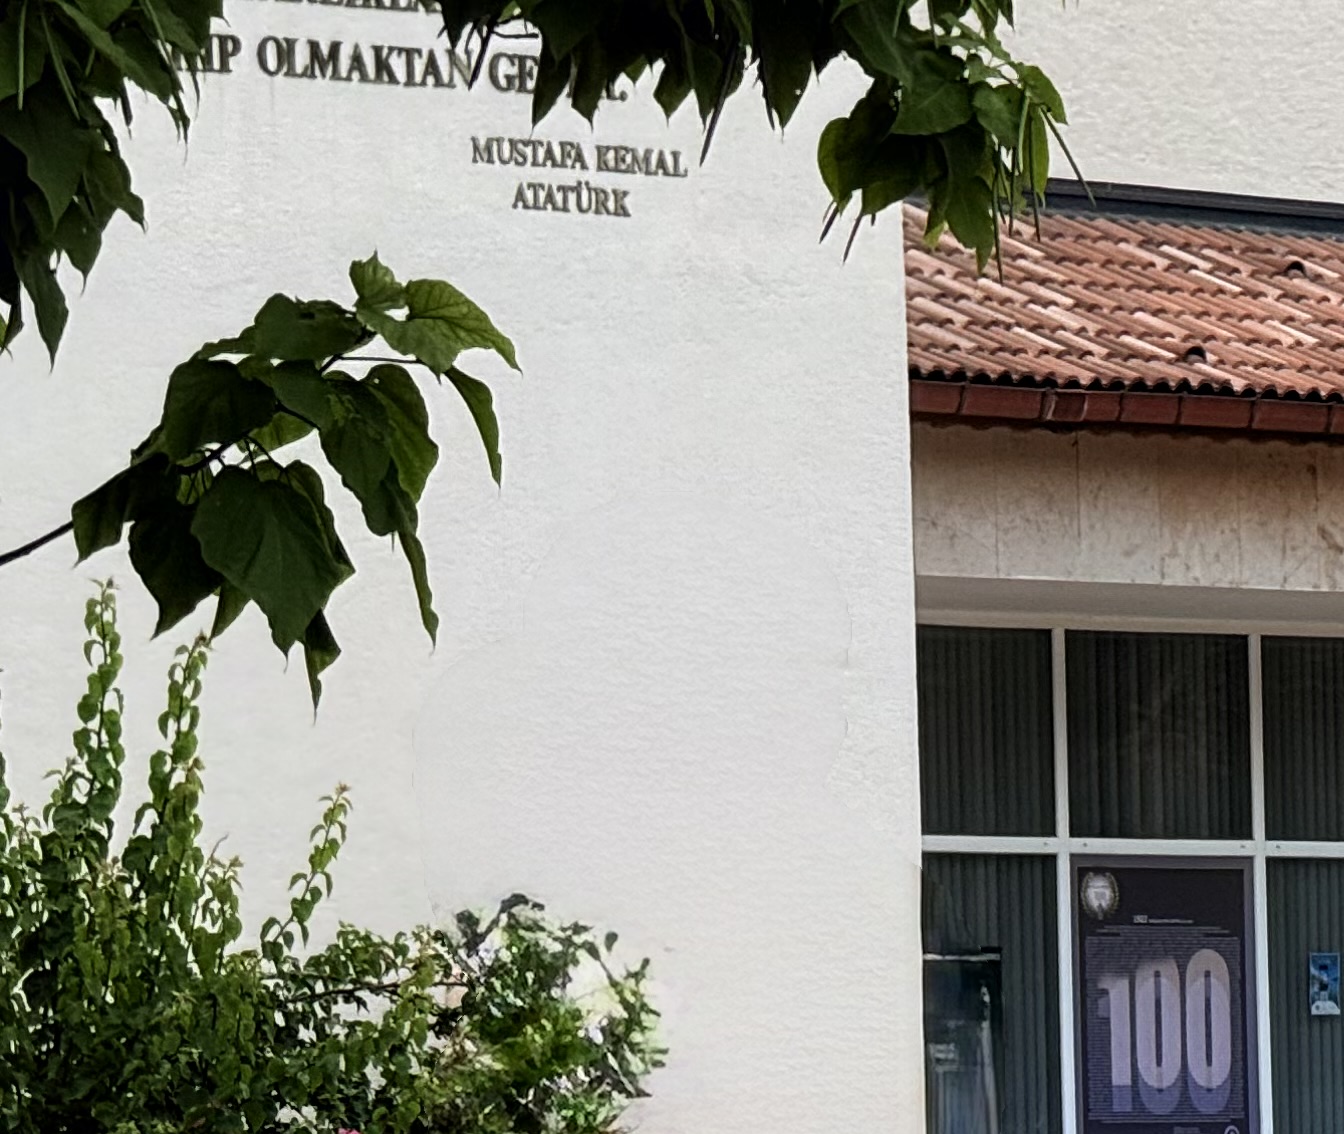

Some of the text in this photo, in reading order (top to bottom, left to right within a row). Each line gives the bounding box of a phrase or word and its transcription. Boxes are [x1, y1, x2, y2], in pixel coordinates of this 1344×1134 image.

[256, 35, 475, 89] OLMAKTAN
[471, 136, 688, 178] MUSTAFA KEMAL
[511, 181, 631, 217] ATATÜRK
[1096, 948, 1232, 1115] 100
